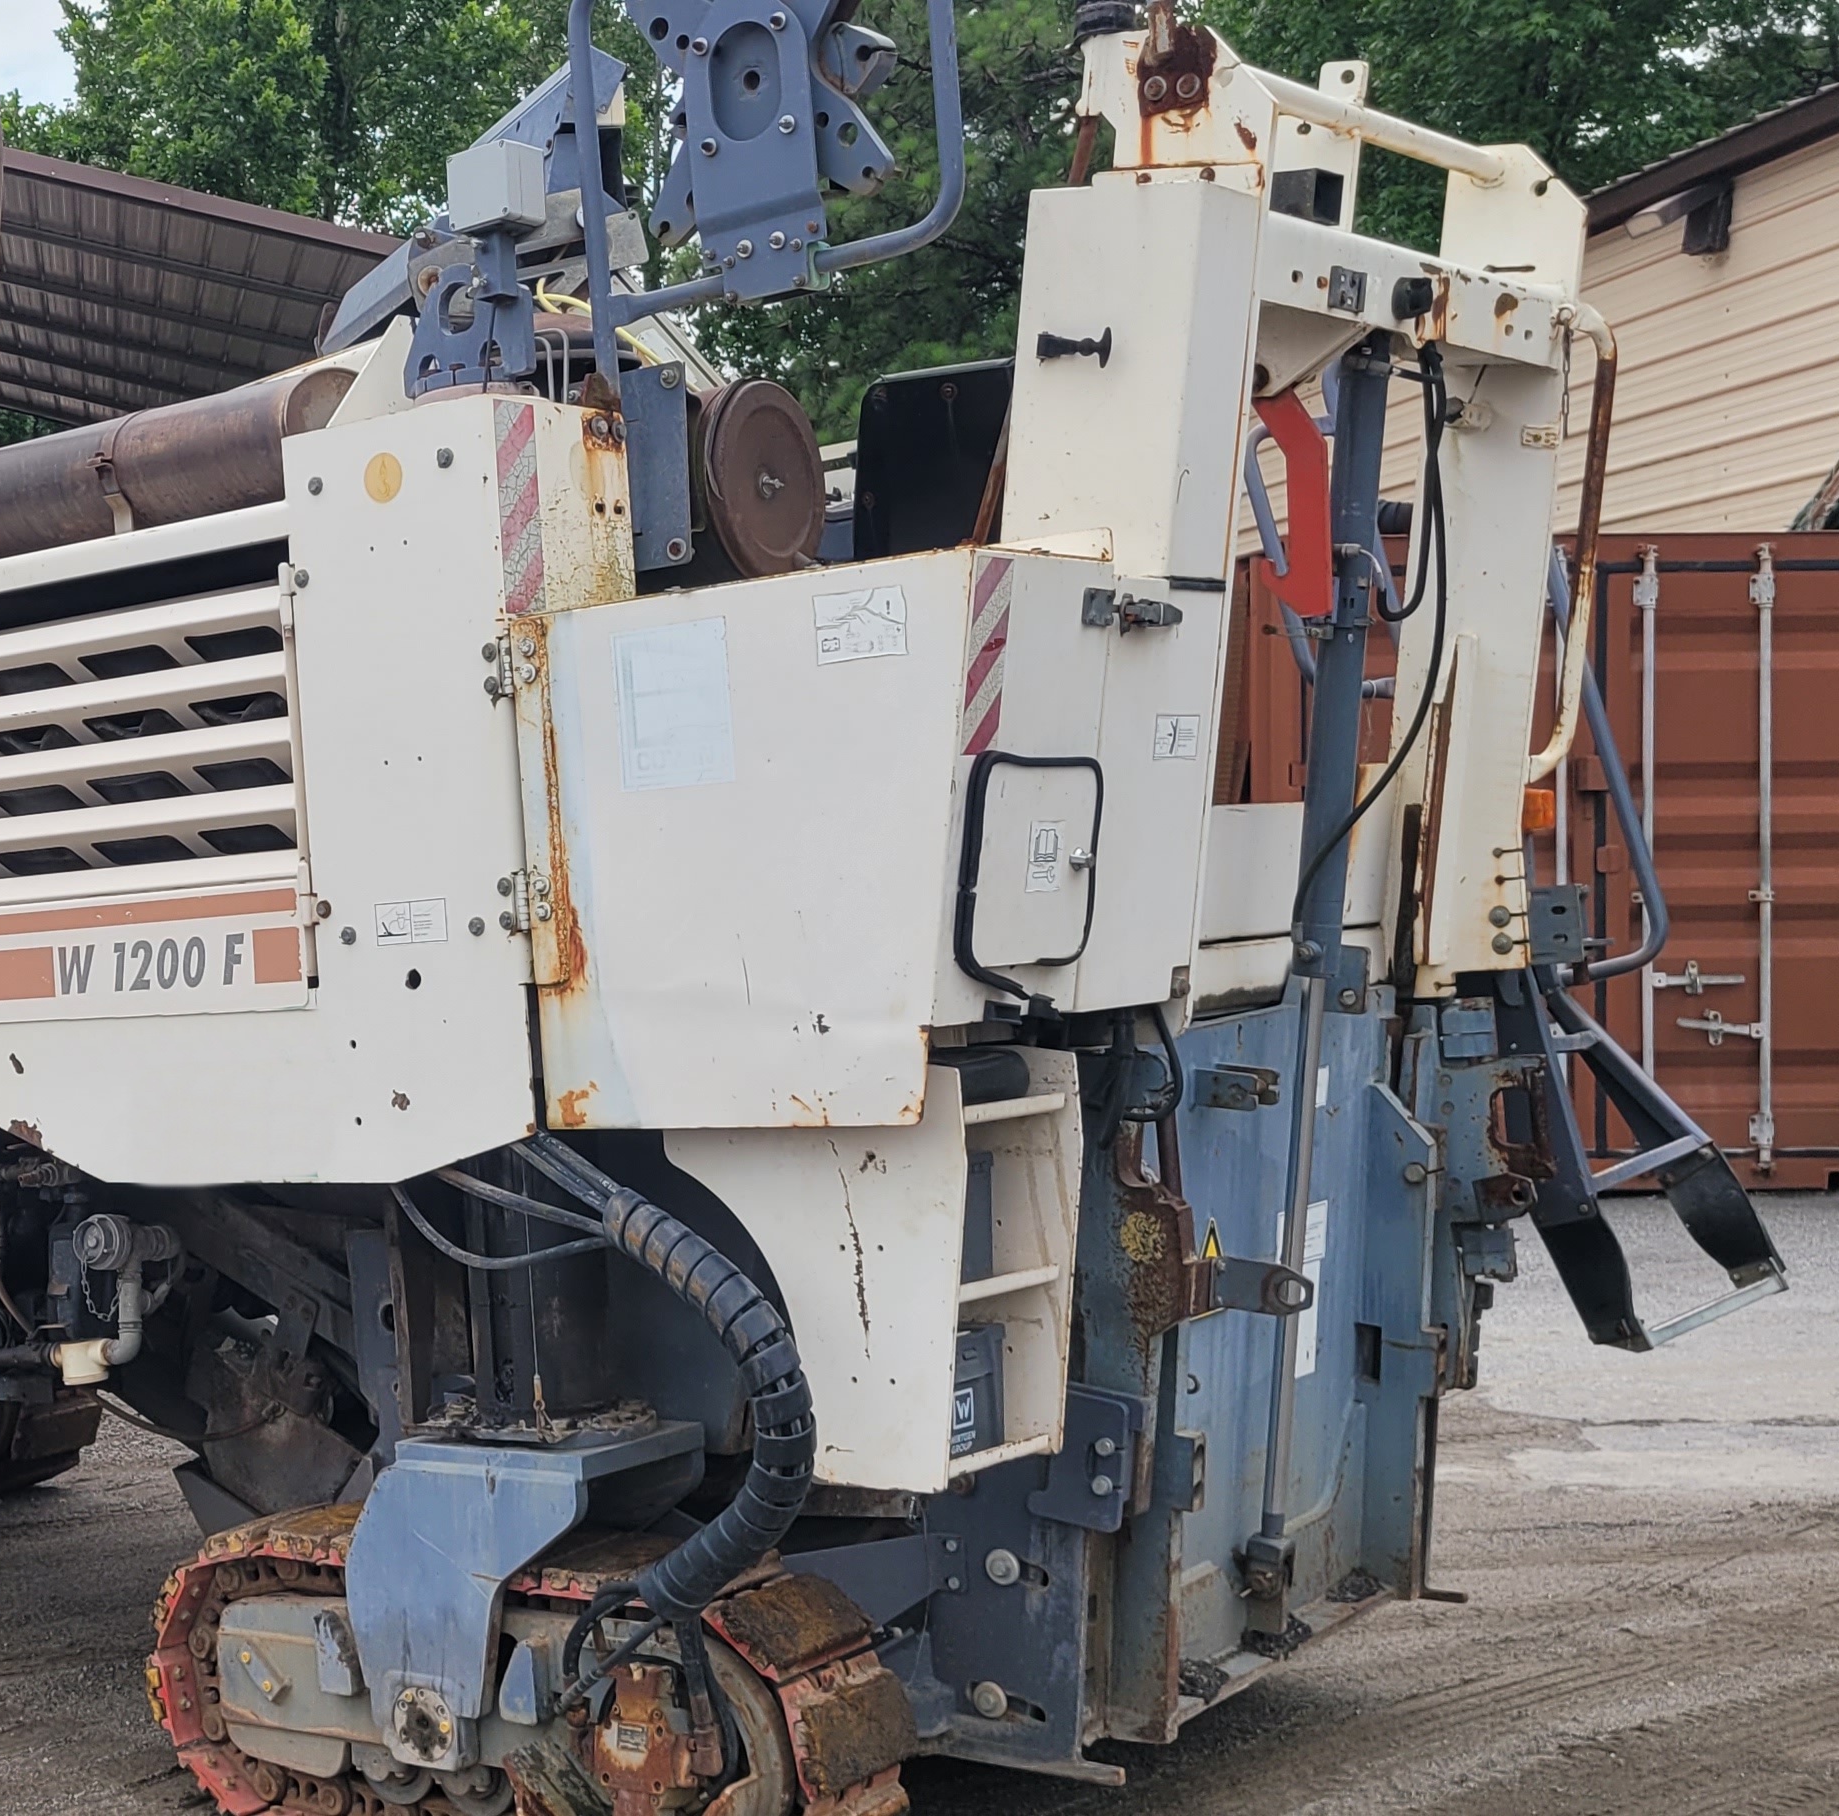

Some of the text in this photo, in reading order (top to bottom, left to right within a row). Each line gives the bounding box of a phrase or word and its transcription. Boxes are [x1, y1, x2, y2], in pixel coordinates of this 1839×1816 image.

[57, 932, 245, 995] W 1200 F
[955, 1397, 971, 1420] W
